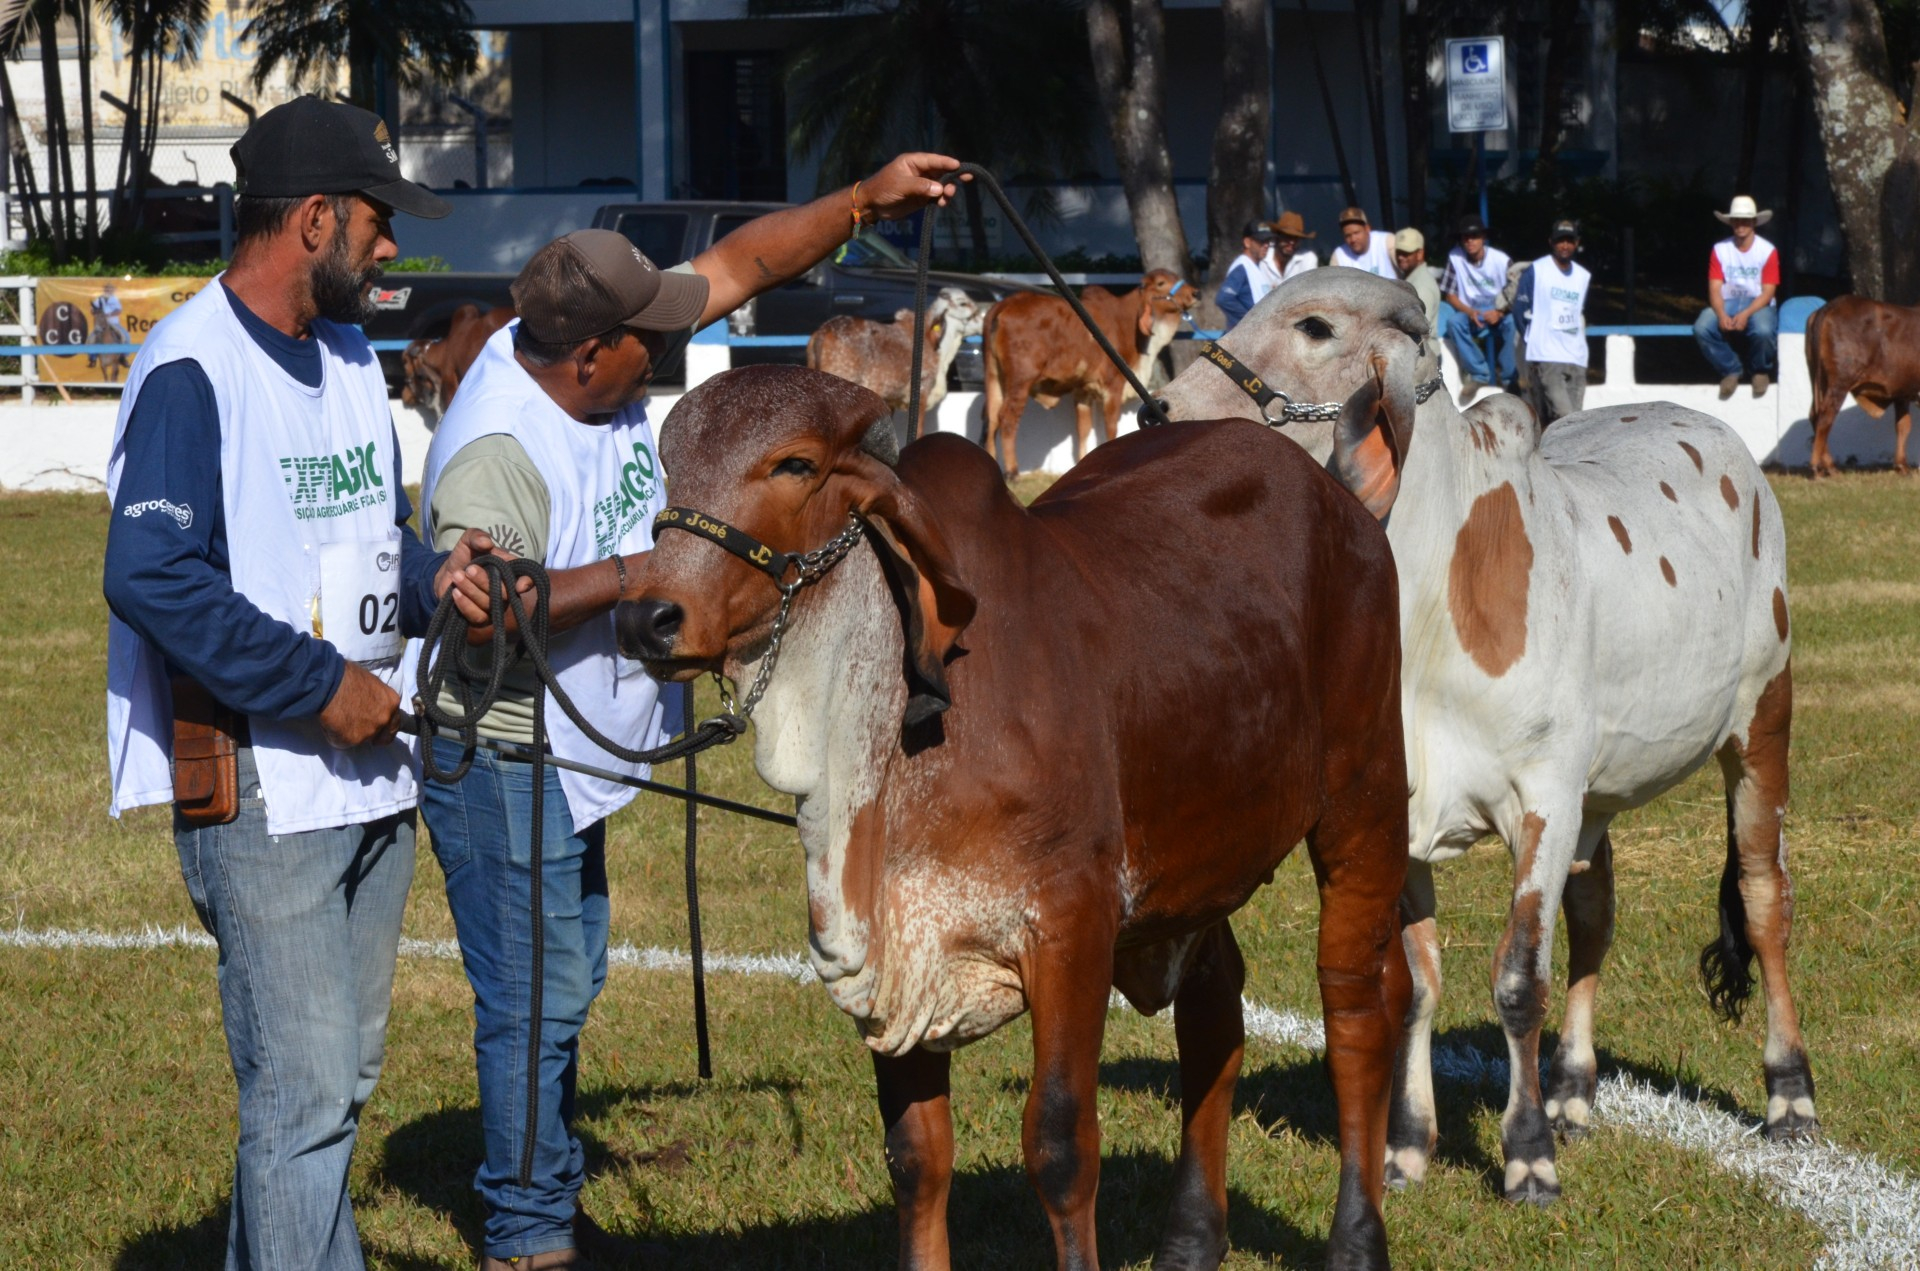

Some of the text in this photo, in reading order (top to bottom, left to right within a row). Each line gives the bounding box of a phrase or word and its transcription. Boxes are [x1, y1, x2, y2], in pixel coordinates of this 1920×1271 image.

[1452, 77, 1499, 86] MASCULINO
[1454, 92, 1498, 100] BANHEIRO
[1461, 102, 1493, 111] DE USO
[56, 305, 69, 321] C
[68, 329, 82, 345] G
[1210, 348, 1235, 369] José
[123, 498, 191, 521] agroceres
[685, 511, 728, 539] José
